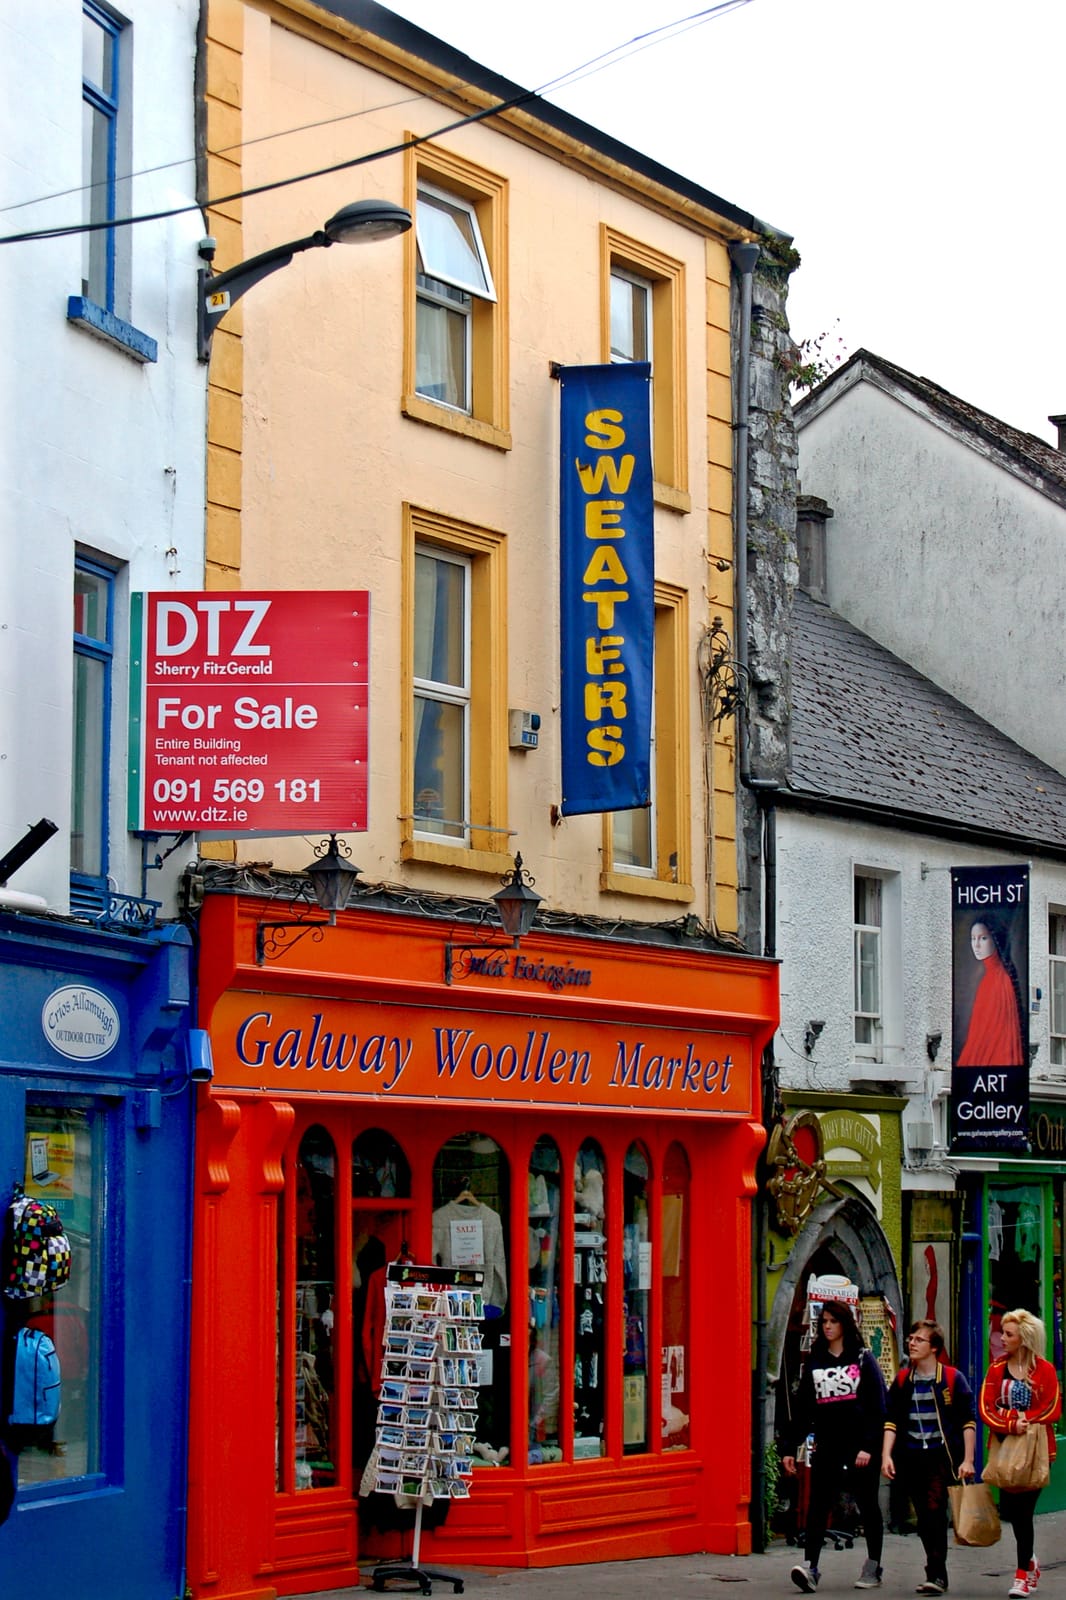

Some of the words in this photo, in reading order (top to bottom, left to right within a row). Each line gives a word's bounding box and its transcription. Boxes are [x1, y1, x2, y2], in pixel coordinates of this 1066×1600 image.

[212, 294, 224, 306] 21
[575, 408, 635, 766] SWEATERS
[156, 601, 272, 656] DTZ
[155, 661, 200, 679] Sherry
[203, 660, 273, 675] FitzGerald
[158, 698, 222, 729] For
[233, 697, 318, 729] Sale
[155, 738, 190, 750] Entire
[193, 738, 241, 751] Building
[155, 754, 195, 765] Tenant
[198, 754, 217, 765] not
[220, 754, 268, 765] affected
[153, 779, 201, 803] 091
[212, 779, 265, 803] 569
[274, 779, 321, 803] 181
[153, 806, 248, 822] www.dtz.ie
[958, 885, 1002, 904] HIGH
[1006, 884, 1024, 903] ST
[56, 1030, 83, 1043] OUTDOOR
[84, 1032, 106, 1045] CENTRE
[235, 1012, 413, 1090] Galway
[432, 1028, 592, 1085] Woollen
[608, 1041, 734, 1094] Market
[973, 1074, 1008, 1093] ART
[957, 1101, 1023, 1123] Gallery
[821, 1119, 838, 1142] WAY
[854, 1121, 876, 1155] GIFTS
[957, 1129, 1024, 1139] www.galwayartgallery.com
